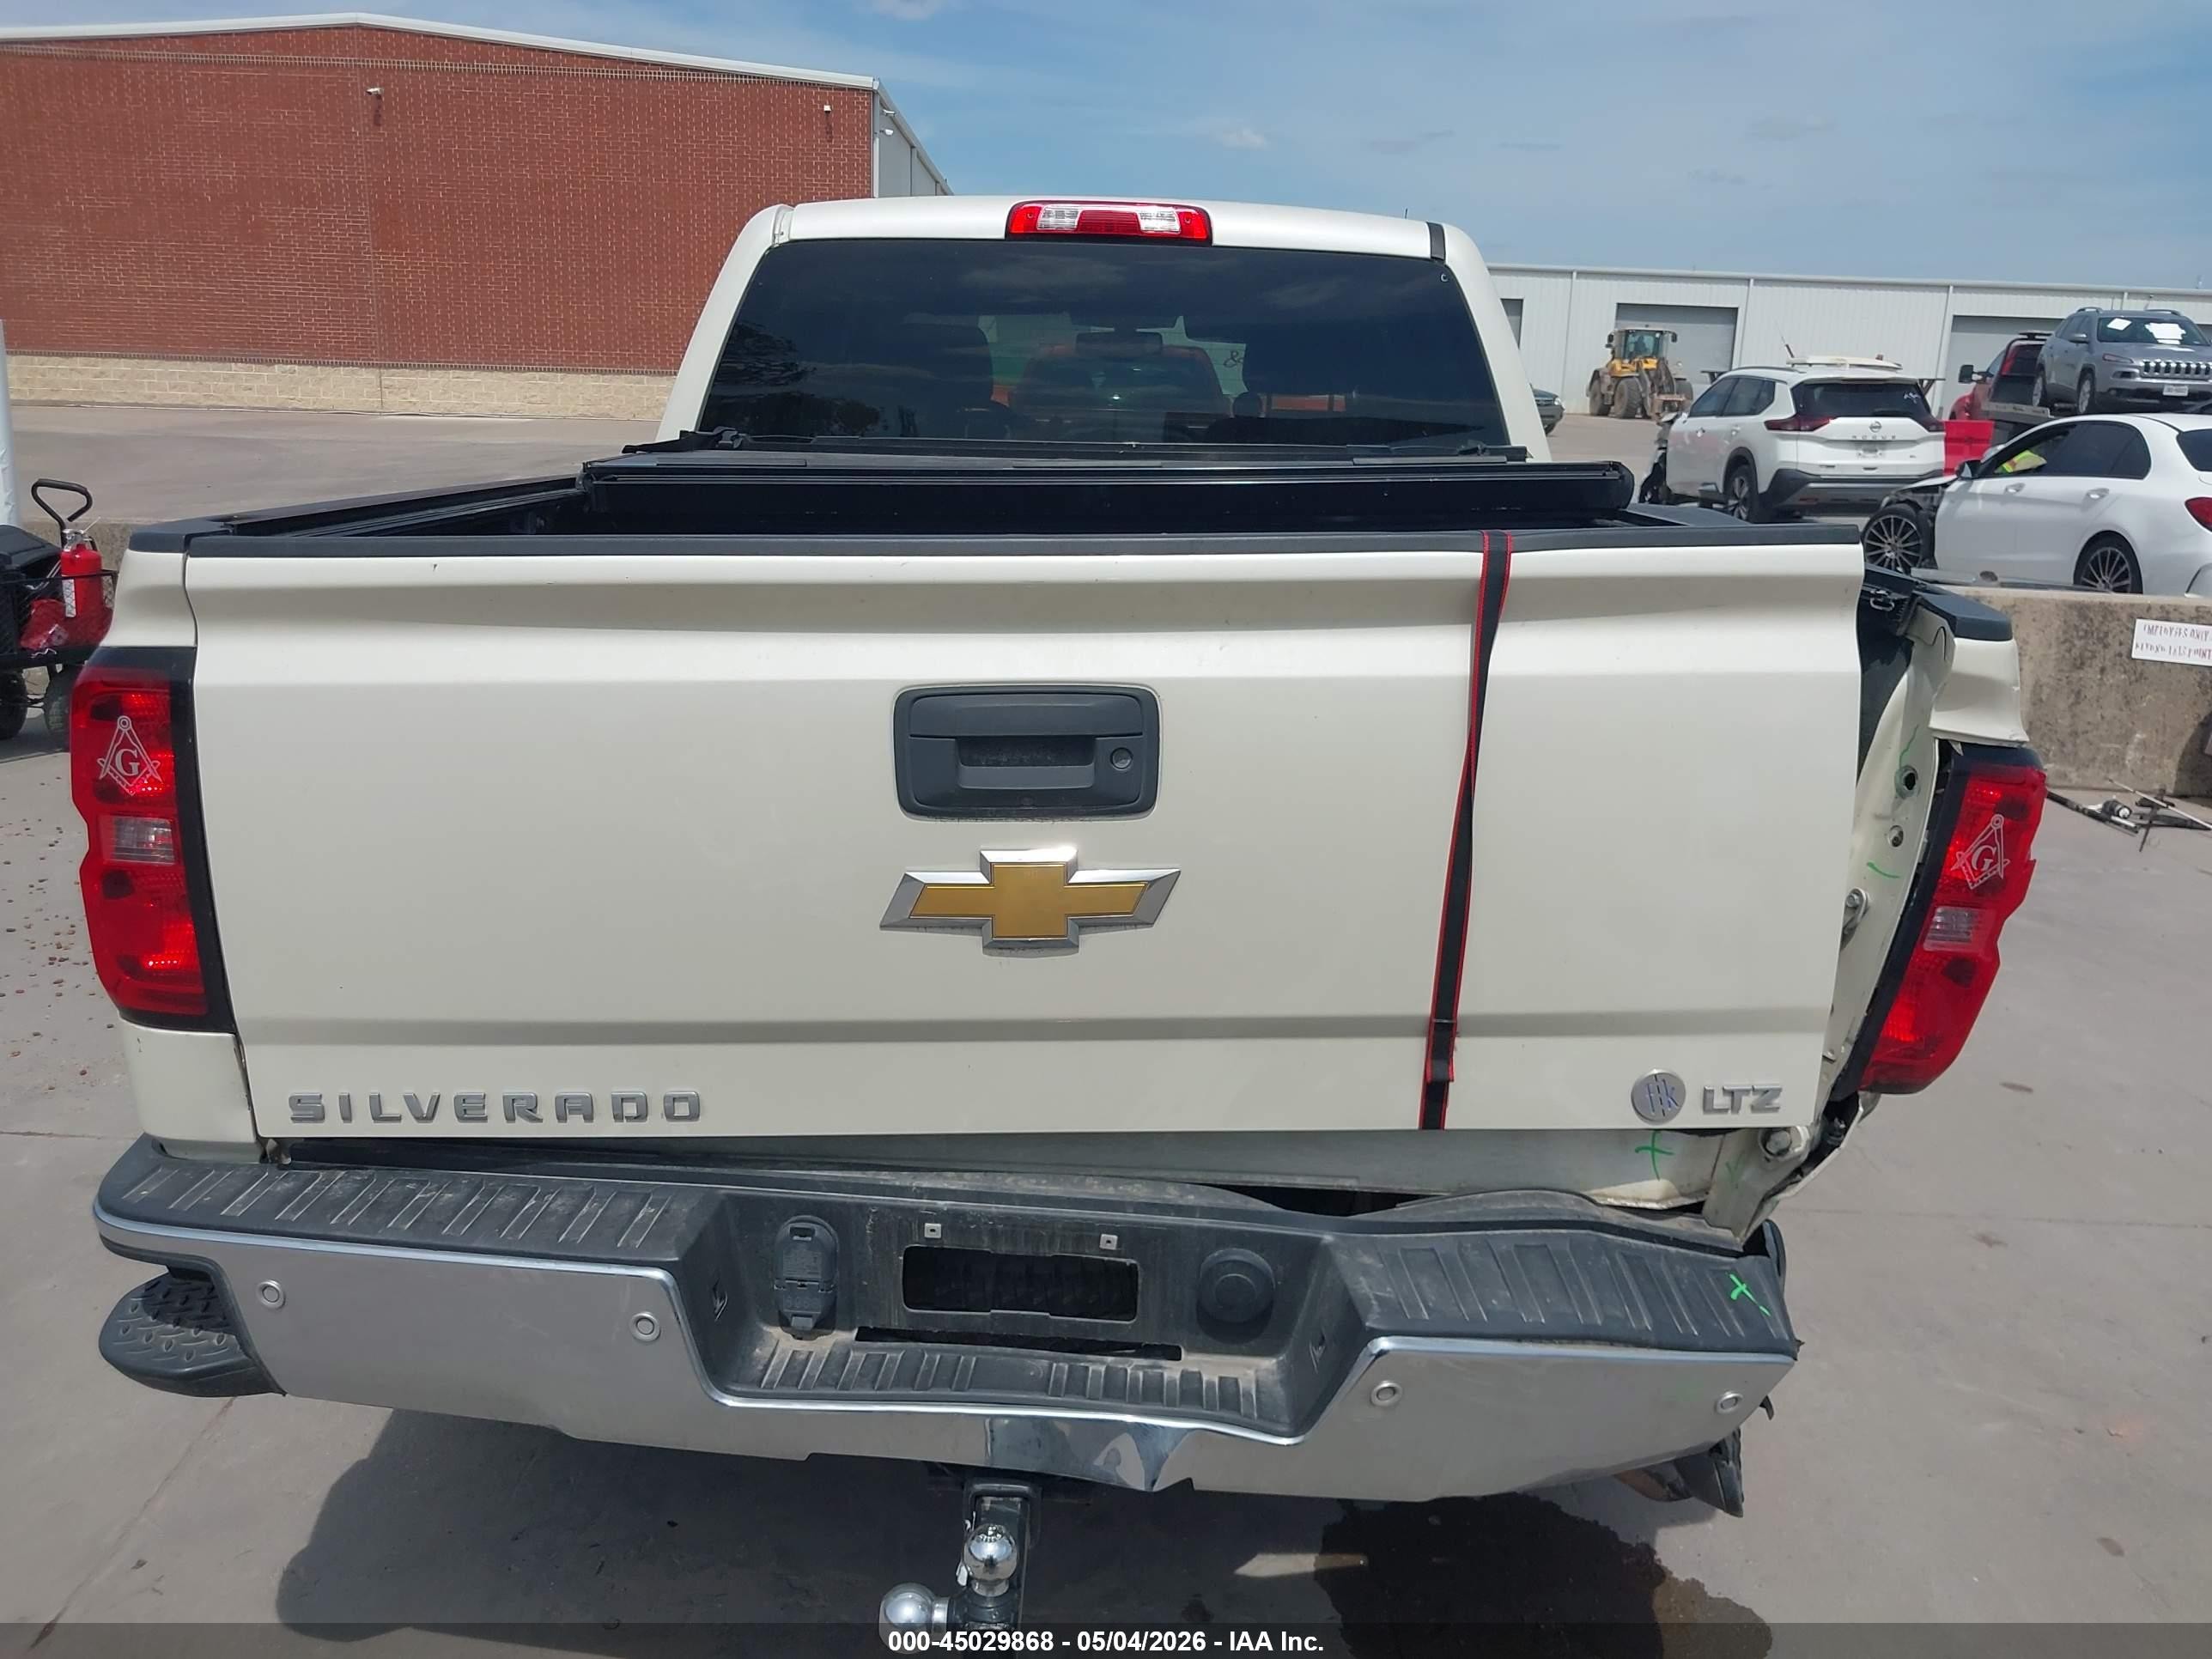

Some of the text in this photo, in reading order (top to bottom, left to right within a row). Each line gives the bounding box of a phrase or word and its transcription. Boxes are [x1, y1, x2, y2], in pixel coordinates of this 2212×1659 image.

[115, 749, 140, 776] G
[1972, 845, 1997, 871] G
[289, 1091, 701, 1123] SILVERADO
[1703, 1085, 1783, 1115] LTZ
